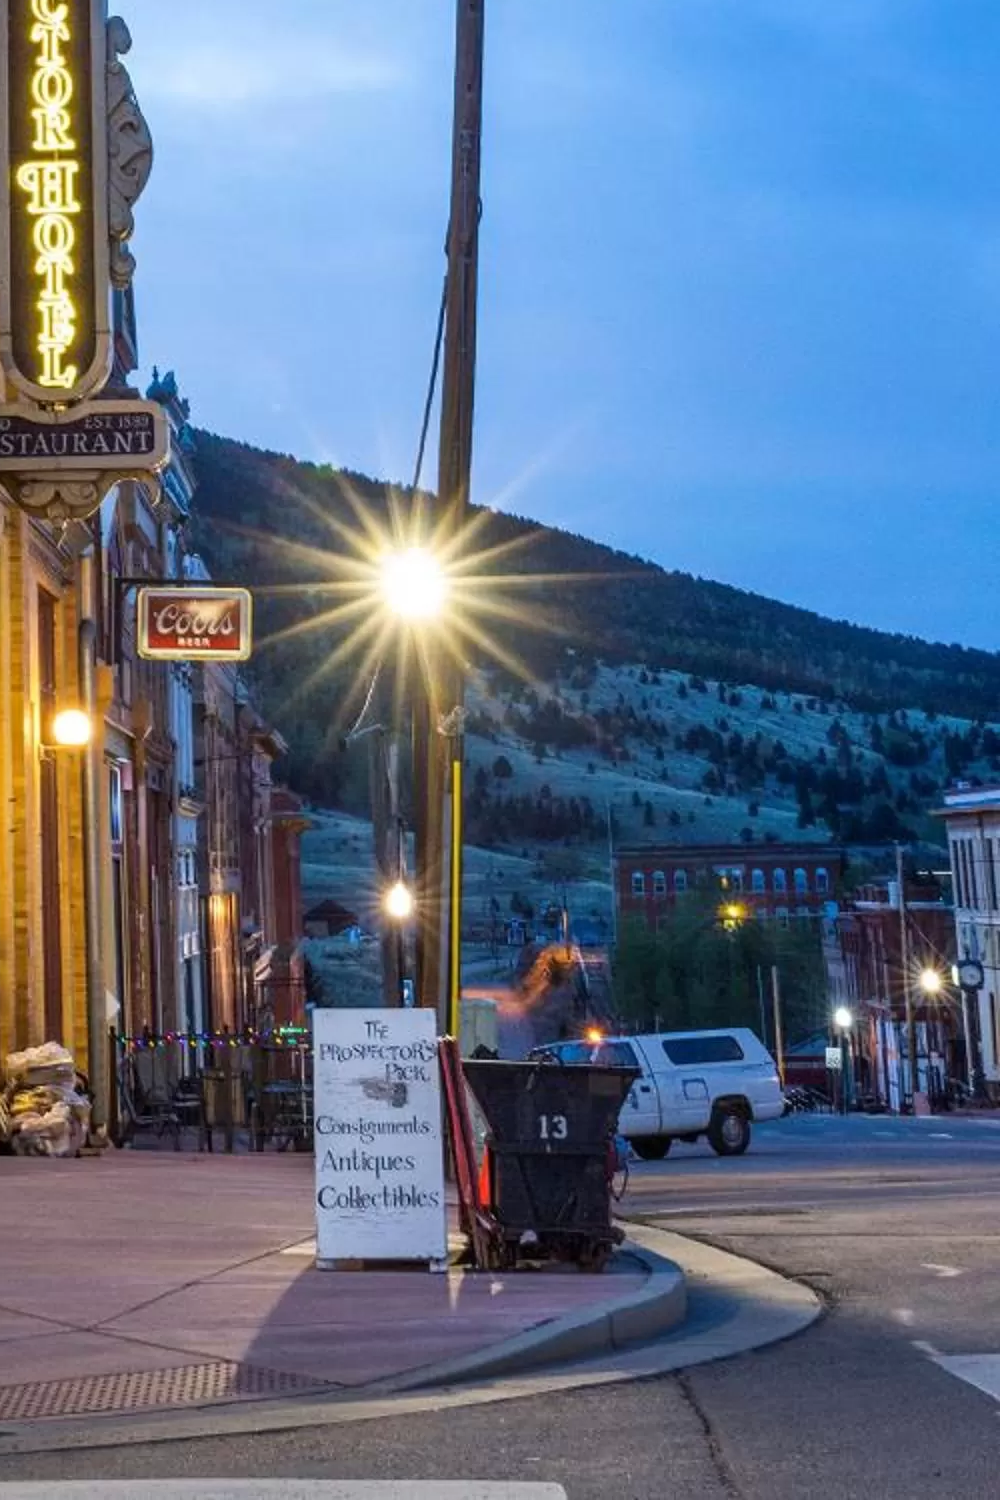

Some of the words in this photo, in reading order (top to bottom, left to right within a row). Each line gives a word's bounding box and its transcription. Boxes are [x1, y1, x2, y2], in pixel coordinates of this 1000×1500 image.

[16, 160, 81, 388] HOTEL
[84, 414, 113, 429] EST
[153, 603, 235, 635] Coors
[316, 1115, 430, 1144] Consignments
[539, 1114, 568, 1139] 13
[320, 1148, 416, 1179] Antiques
[318, 1184, 440, 1209] Collectibles
